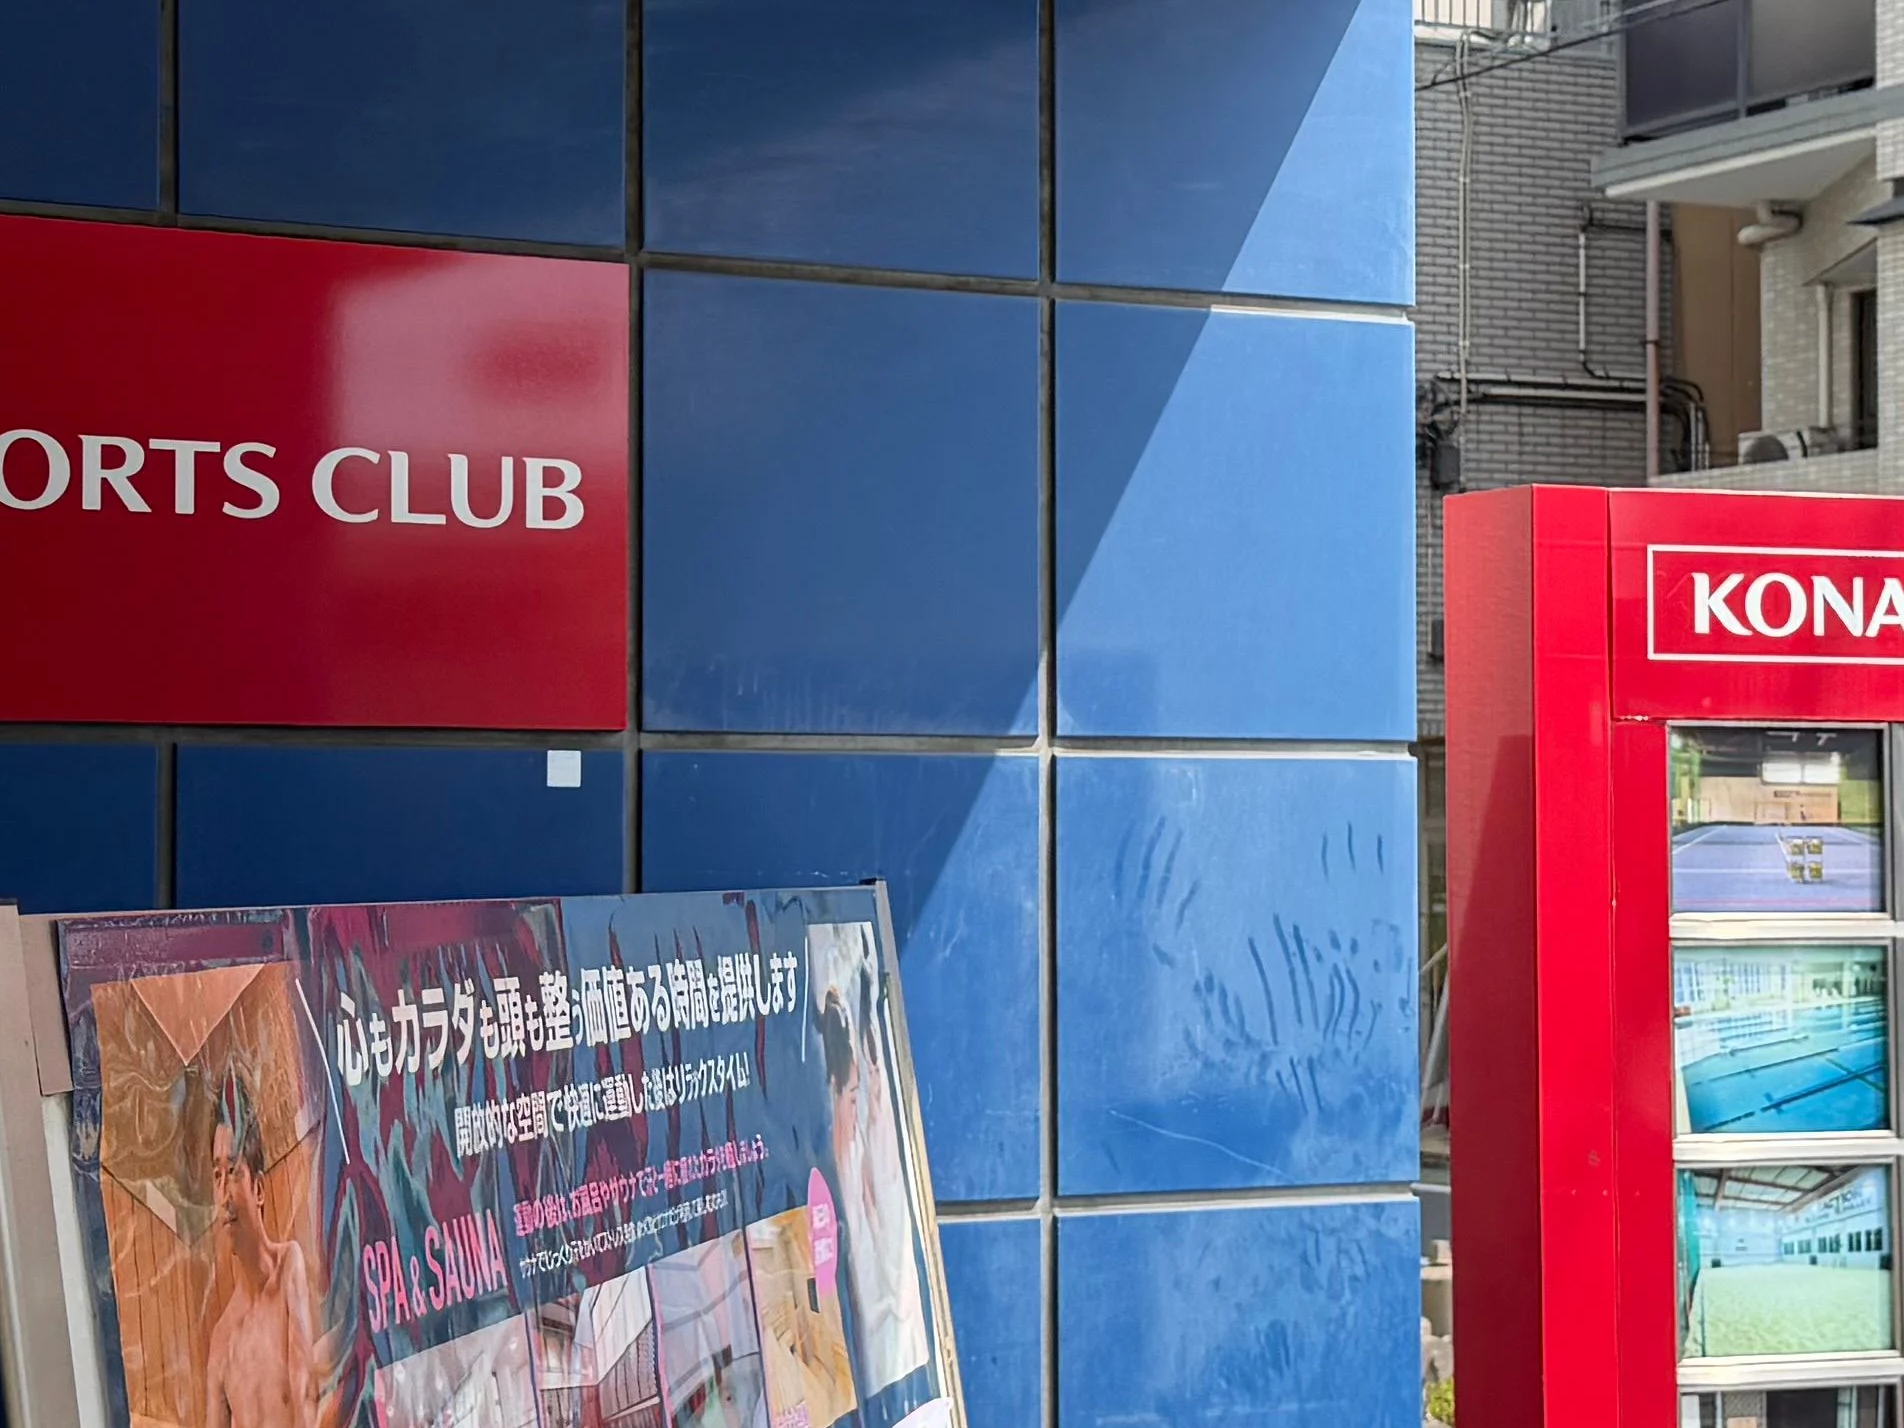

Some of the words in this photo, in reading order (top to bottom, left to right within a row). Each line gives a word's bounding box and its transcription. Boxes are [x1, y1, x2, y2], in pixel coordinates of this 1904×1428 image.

[311, 445, 586, 532] CLUB
[362, 1238, 413, 1334] SPA
[410, 1258, 427, 1318] &
[424, 1209, 510, 1313] SAUNA
